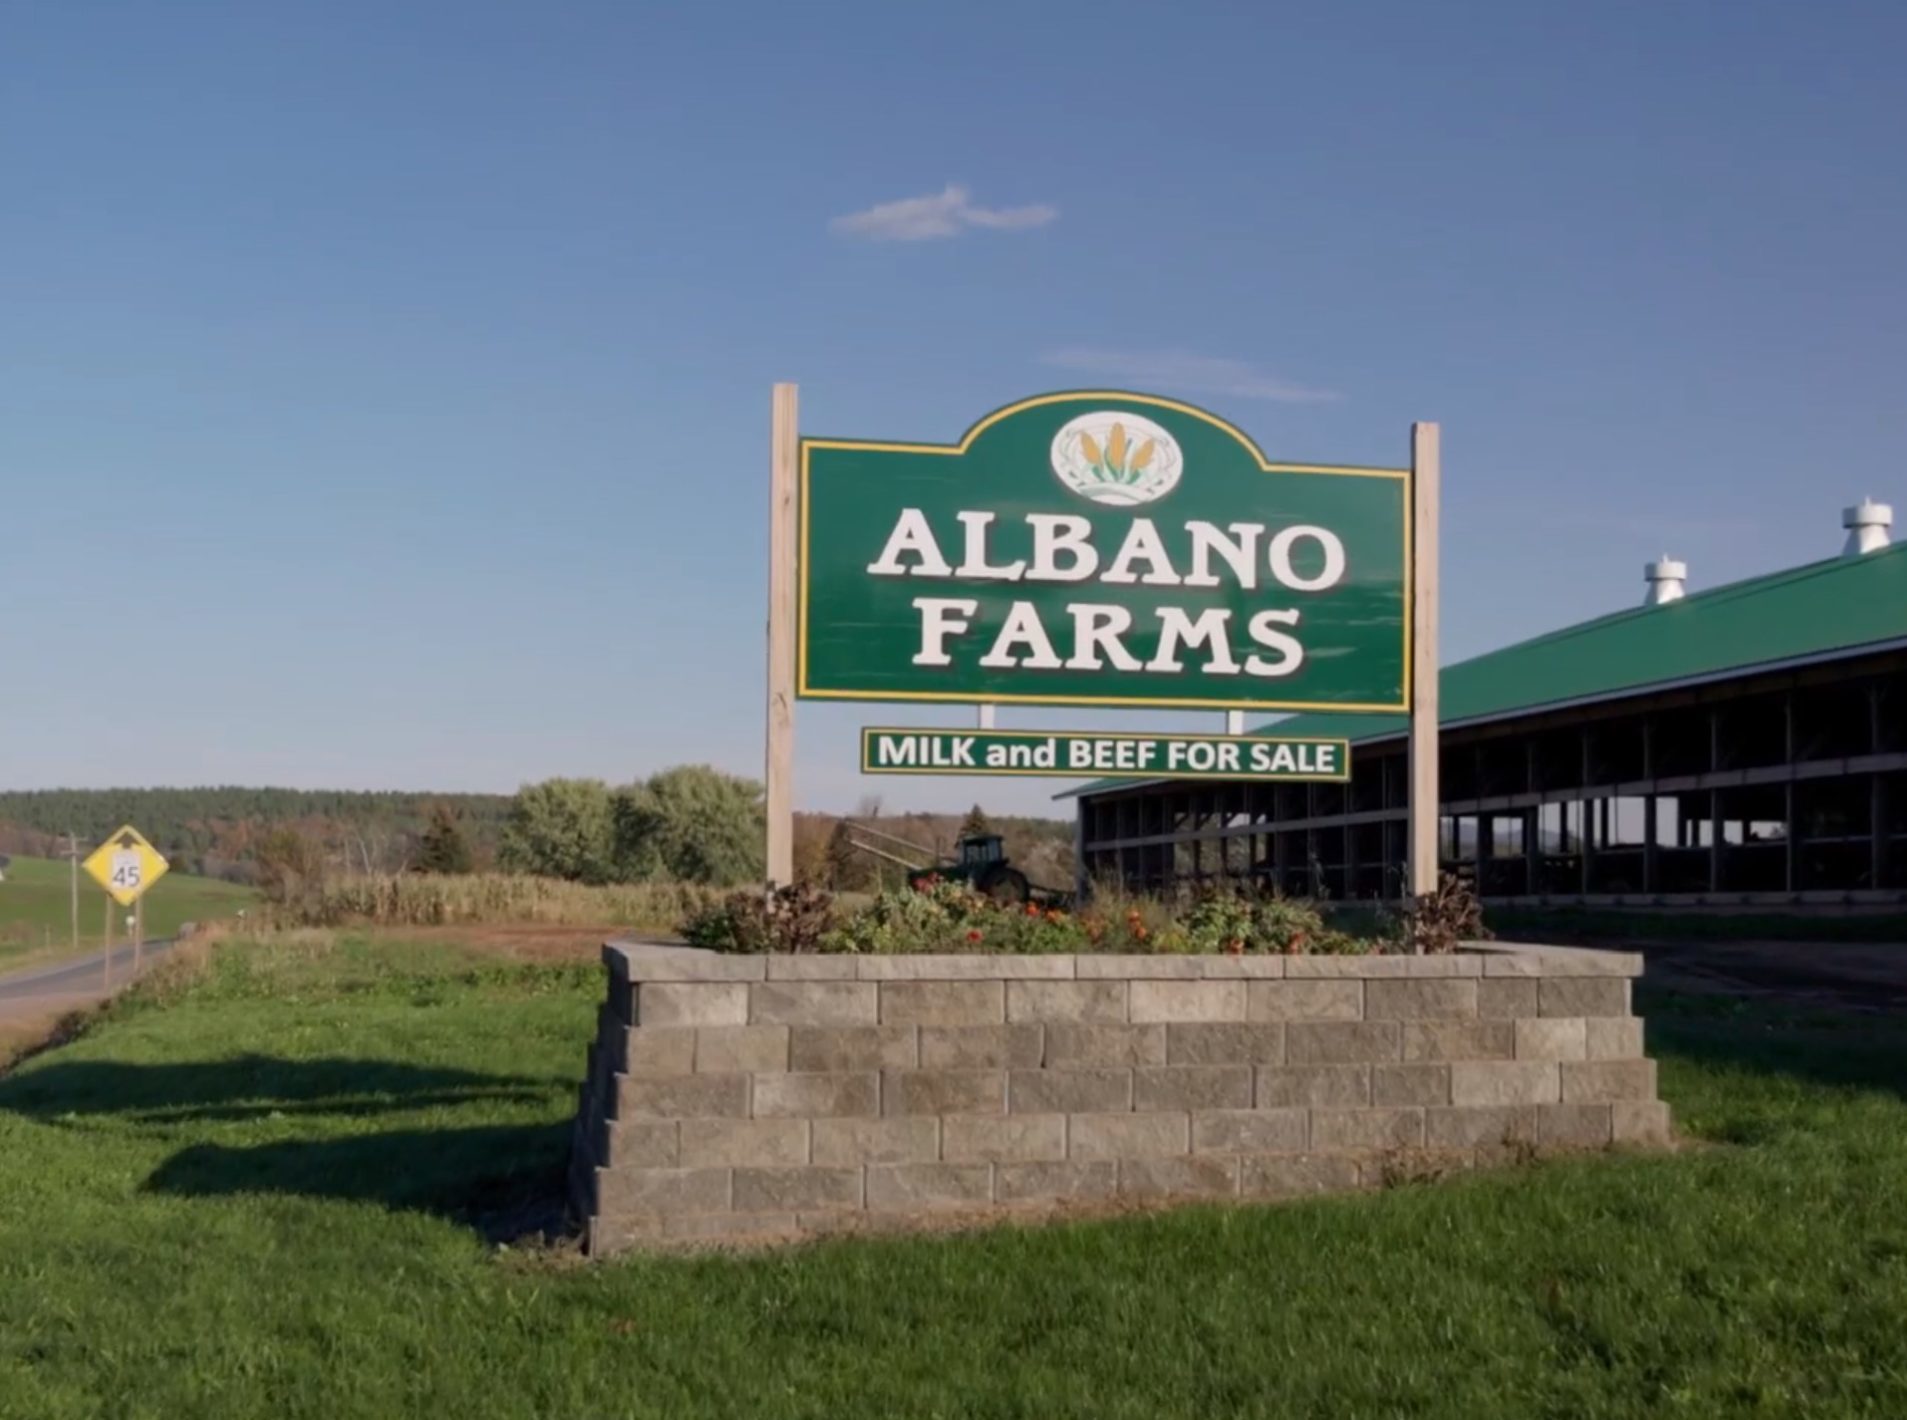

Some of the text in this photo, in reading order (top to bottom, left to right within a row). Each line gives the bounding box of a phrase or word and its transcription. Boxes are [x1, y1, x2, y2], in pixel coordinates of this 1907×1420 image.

[867, 508, 1346, 592] ALBANO
[912, 597, 1304, 676] FARMS
[878, 735, 1336, 773] MILK and BEEF FOR SALE
[113, 866, 140, 887] 45
